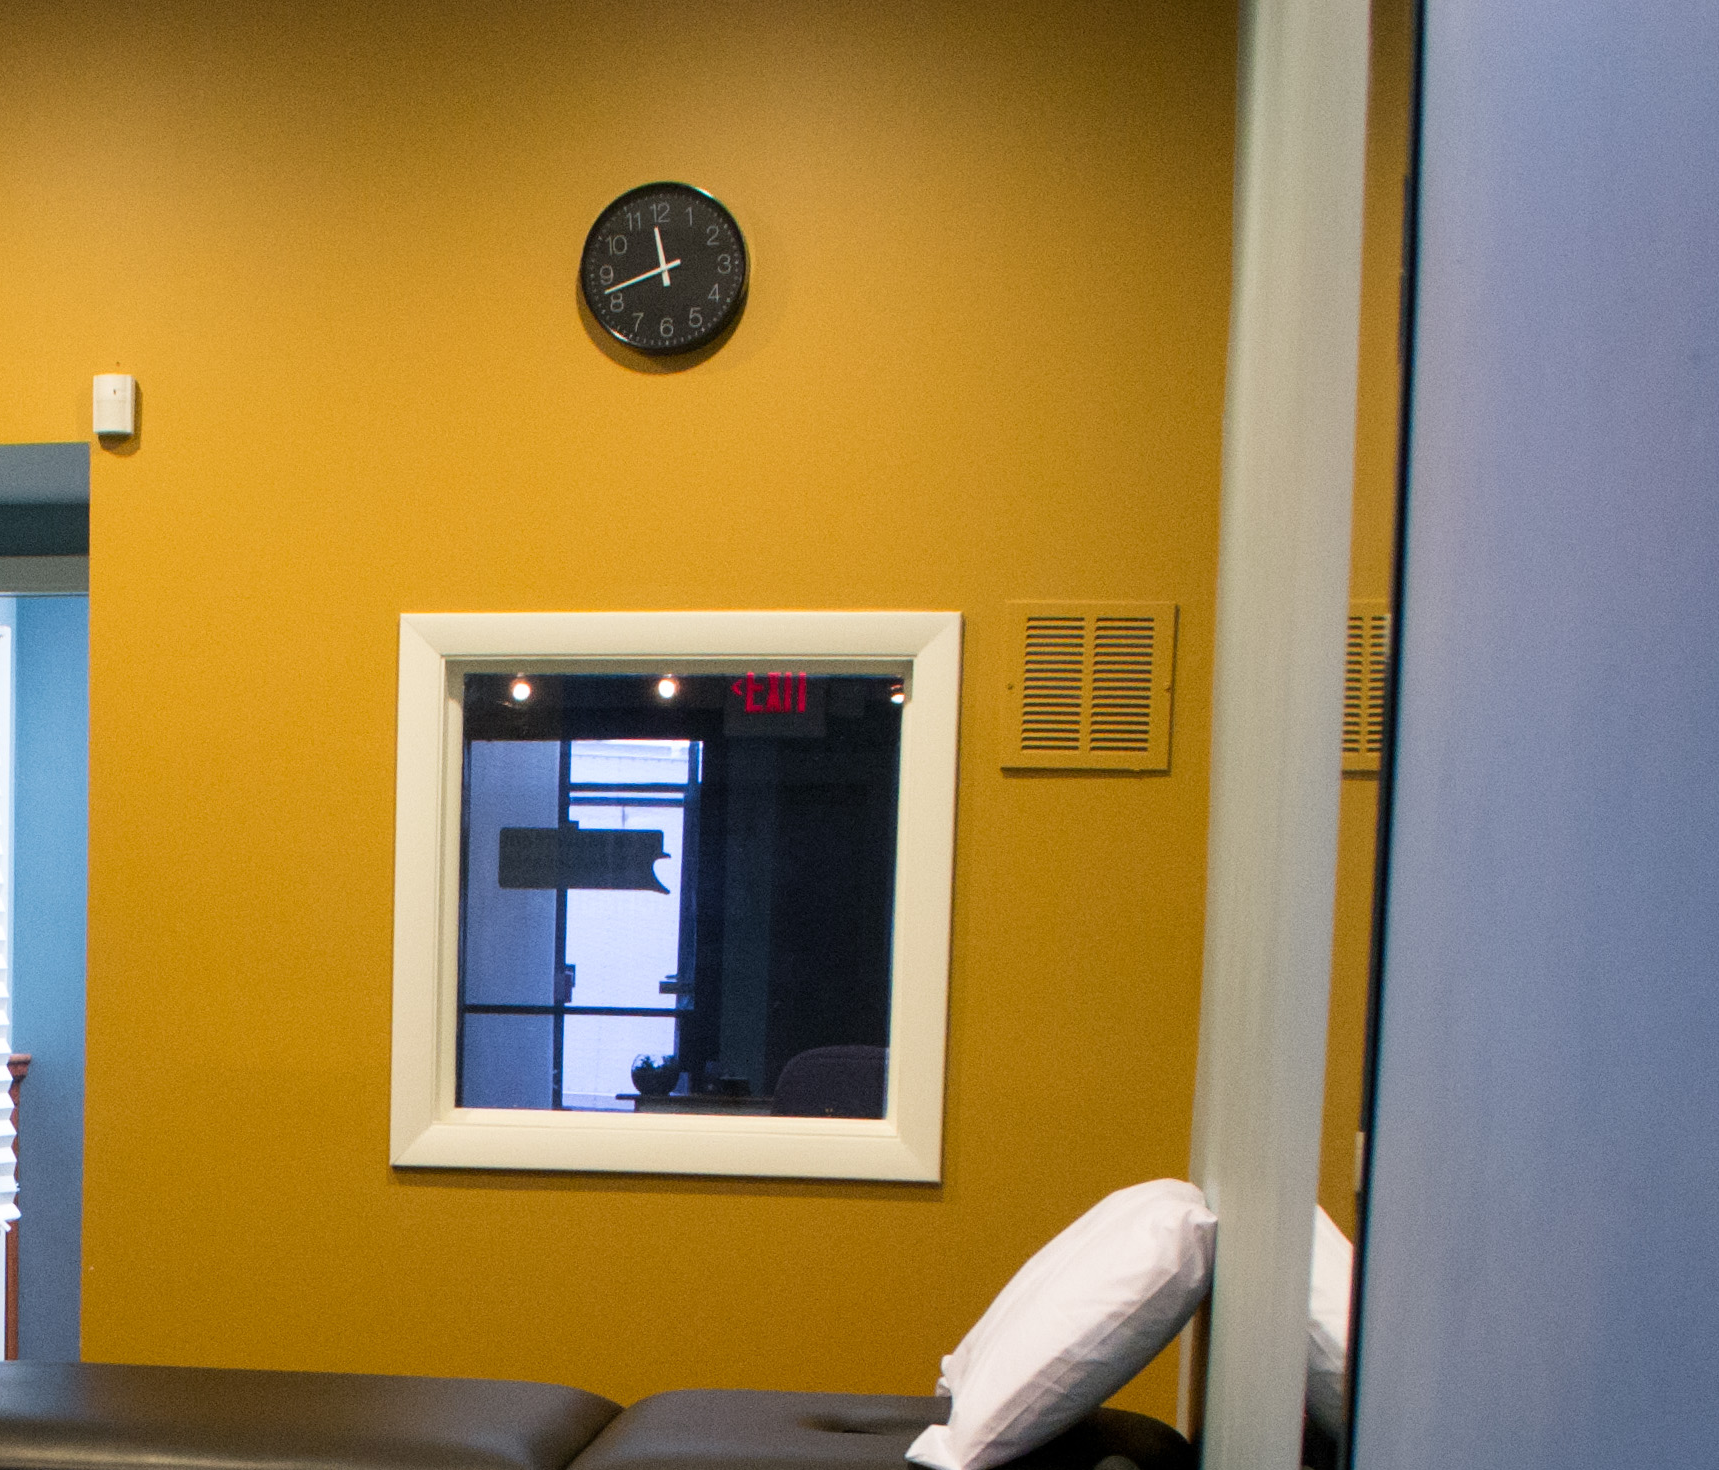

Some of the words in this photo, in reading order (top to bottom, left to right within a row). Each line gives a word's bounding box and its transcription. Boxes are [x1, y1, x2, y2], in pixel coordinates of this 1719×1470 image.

[626, 212, 641, 231] 11
[650, 202, 670, 223] 12
[684, 207, 693, 226] 1
[607, 235, 627, 255] 10
[706, 225, 719, 246] 2
[717, 254, 731, 274] 3
[599, 265, 614, 286] 9
[610, 293, 624, 313] 8
[708, 283, 719, 303] 4
[632, 313, 644, 332] 7
[689, 307, 703, 328] 5
[660, 318, 674, 338] 6
